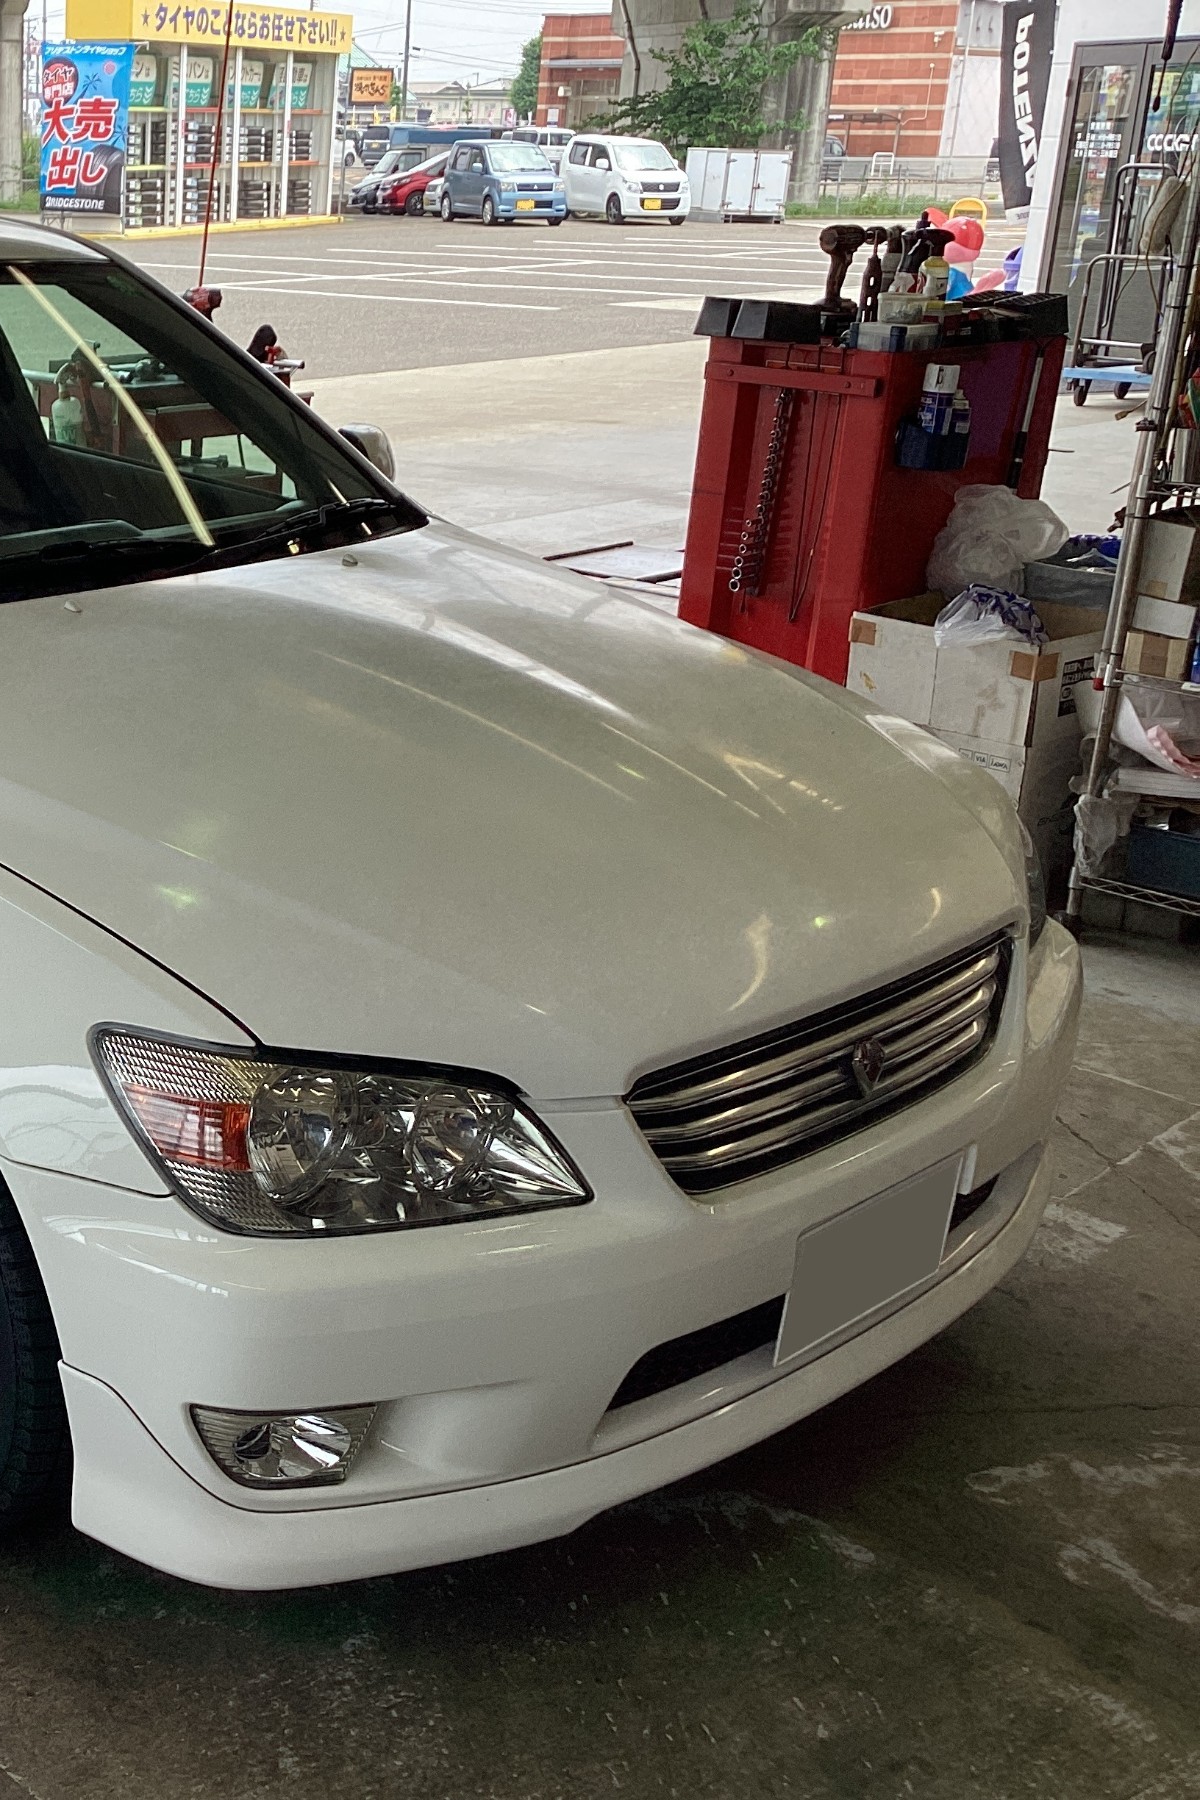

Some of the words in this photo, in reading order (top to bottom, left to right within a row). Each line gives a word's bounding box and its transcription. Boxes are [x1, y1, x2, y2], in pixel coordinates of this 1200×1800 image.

[44, 65, 75, 85] タイヤ
[45, 196, 105, 210] BRIDGESTONE
